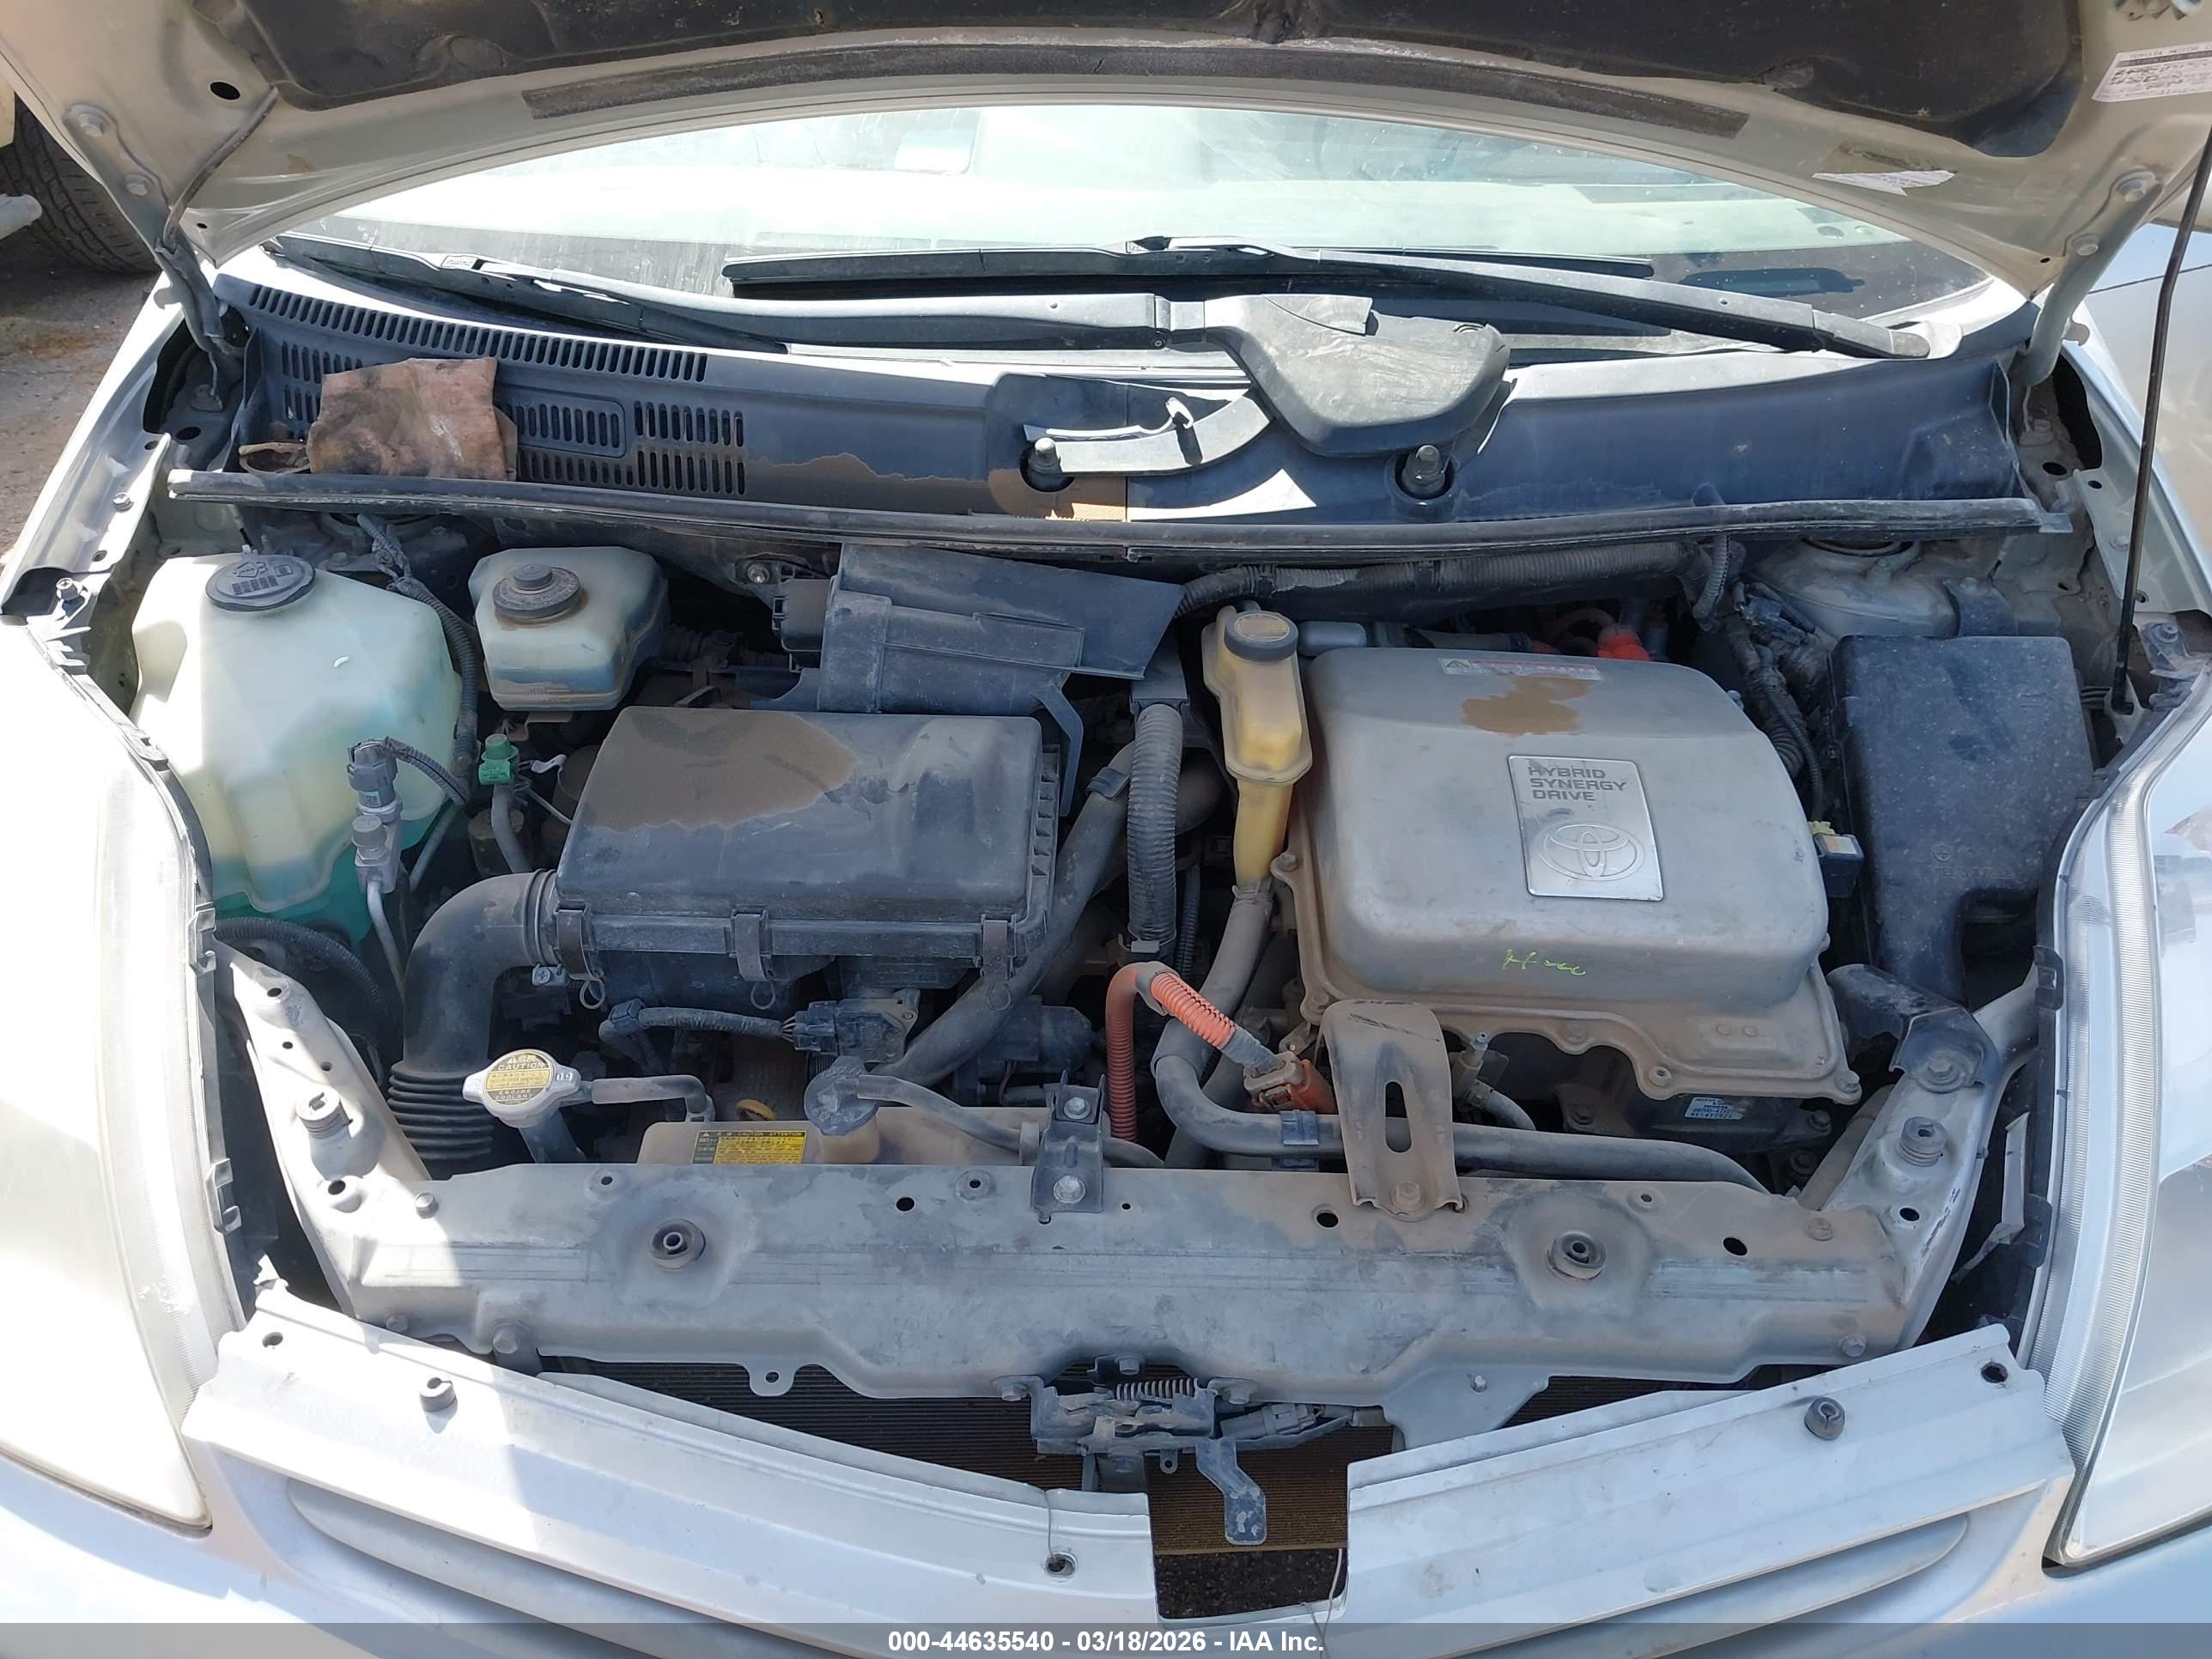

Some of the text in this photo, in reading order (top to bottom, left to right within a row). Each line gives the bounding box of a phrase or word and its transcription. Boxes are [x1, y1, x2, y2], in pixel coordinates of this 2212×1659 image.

[1528, 766, 1607, 779] HYBRID
[1529, 778, 1628, 792] SYNERGY
[1533, 789, 1596, 801] DRIVE
[497, 1061, 546, 1071] CAUTION
[556, 1072, 574, 1082] 0.9
